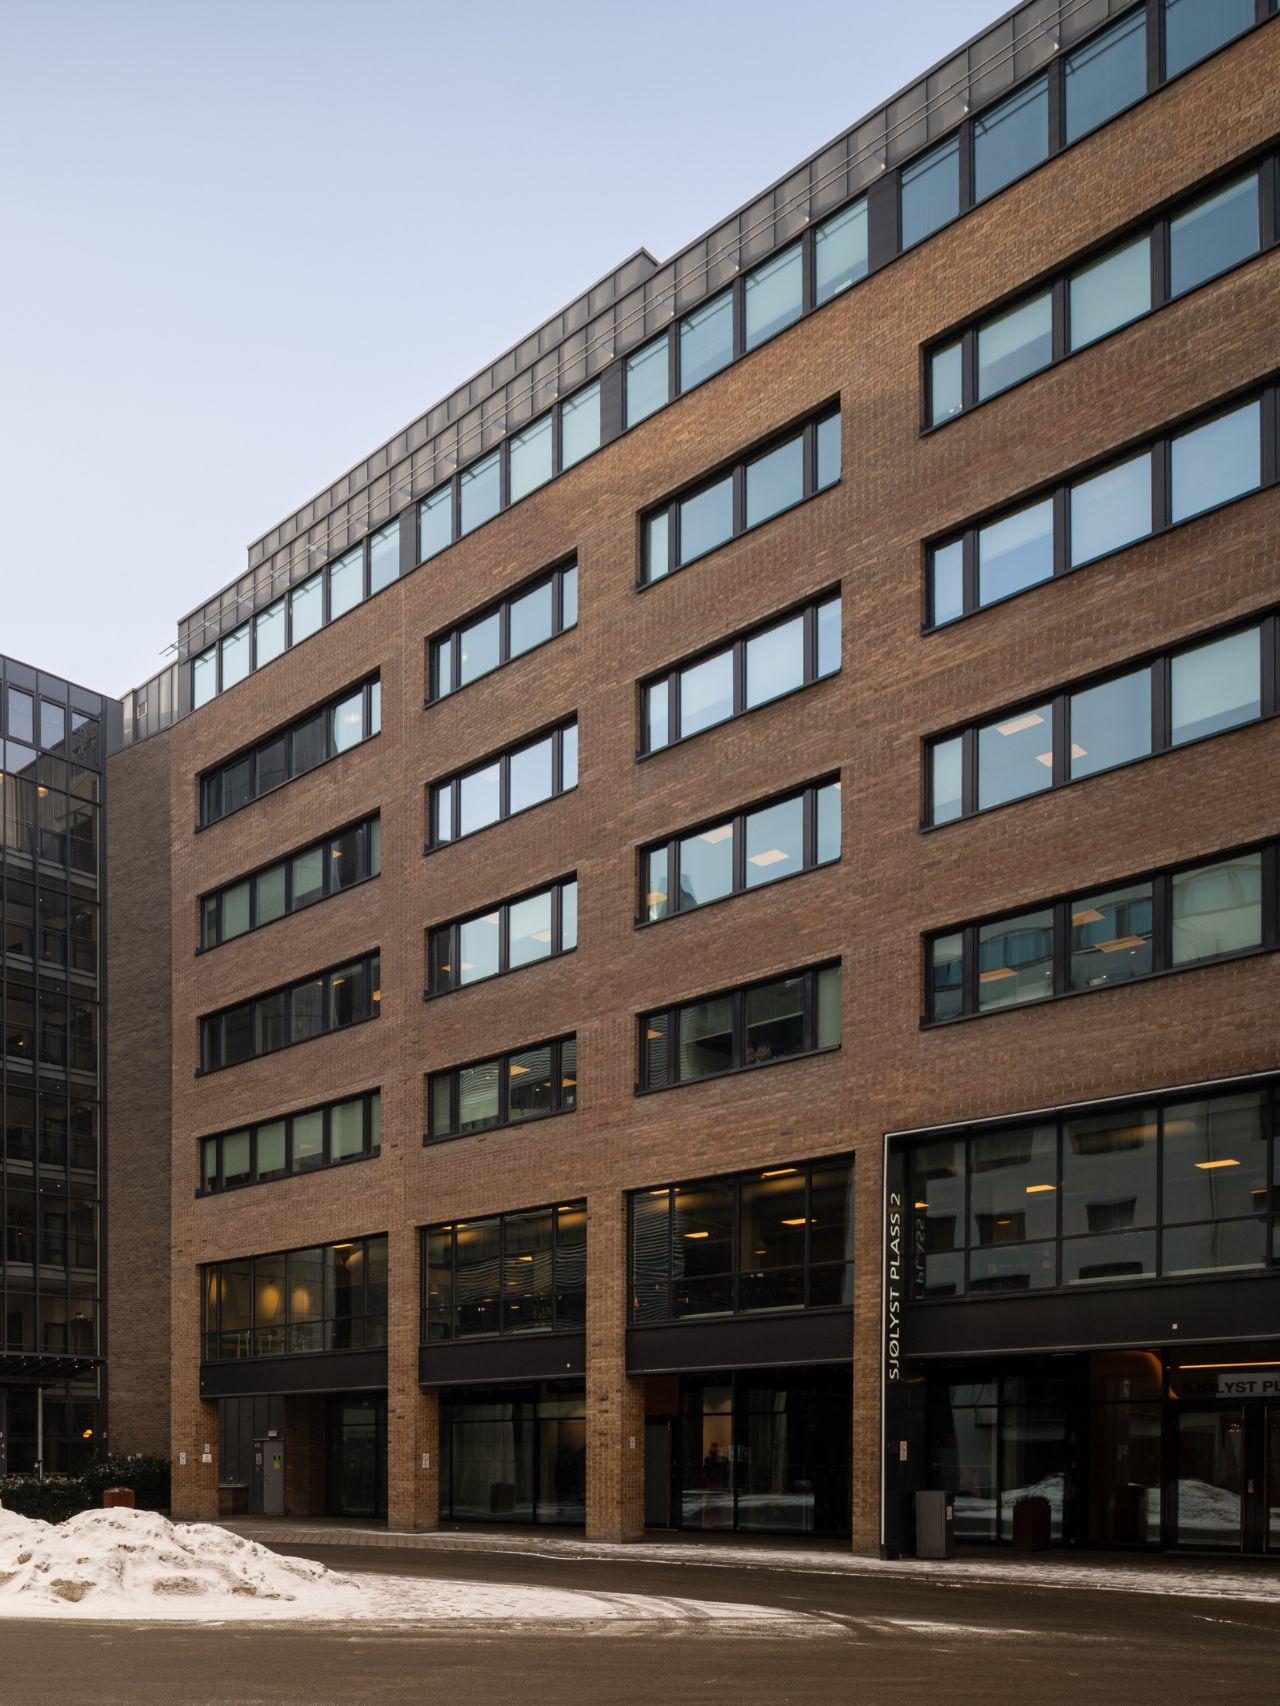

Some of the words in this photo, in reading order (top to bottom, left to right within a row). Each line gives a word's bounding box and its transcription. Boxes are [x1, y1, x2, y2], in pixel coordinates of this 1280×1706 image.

[890, 1192, 901, 1205] 2
[890, 1213, 901, 1280] PLASS
[889, 1286, 900, 1380] SJØLYST
[1183, 1381, 1257, 1394] SJØLYST
